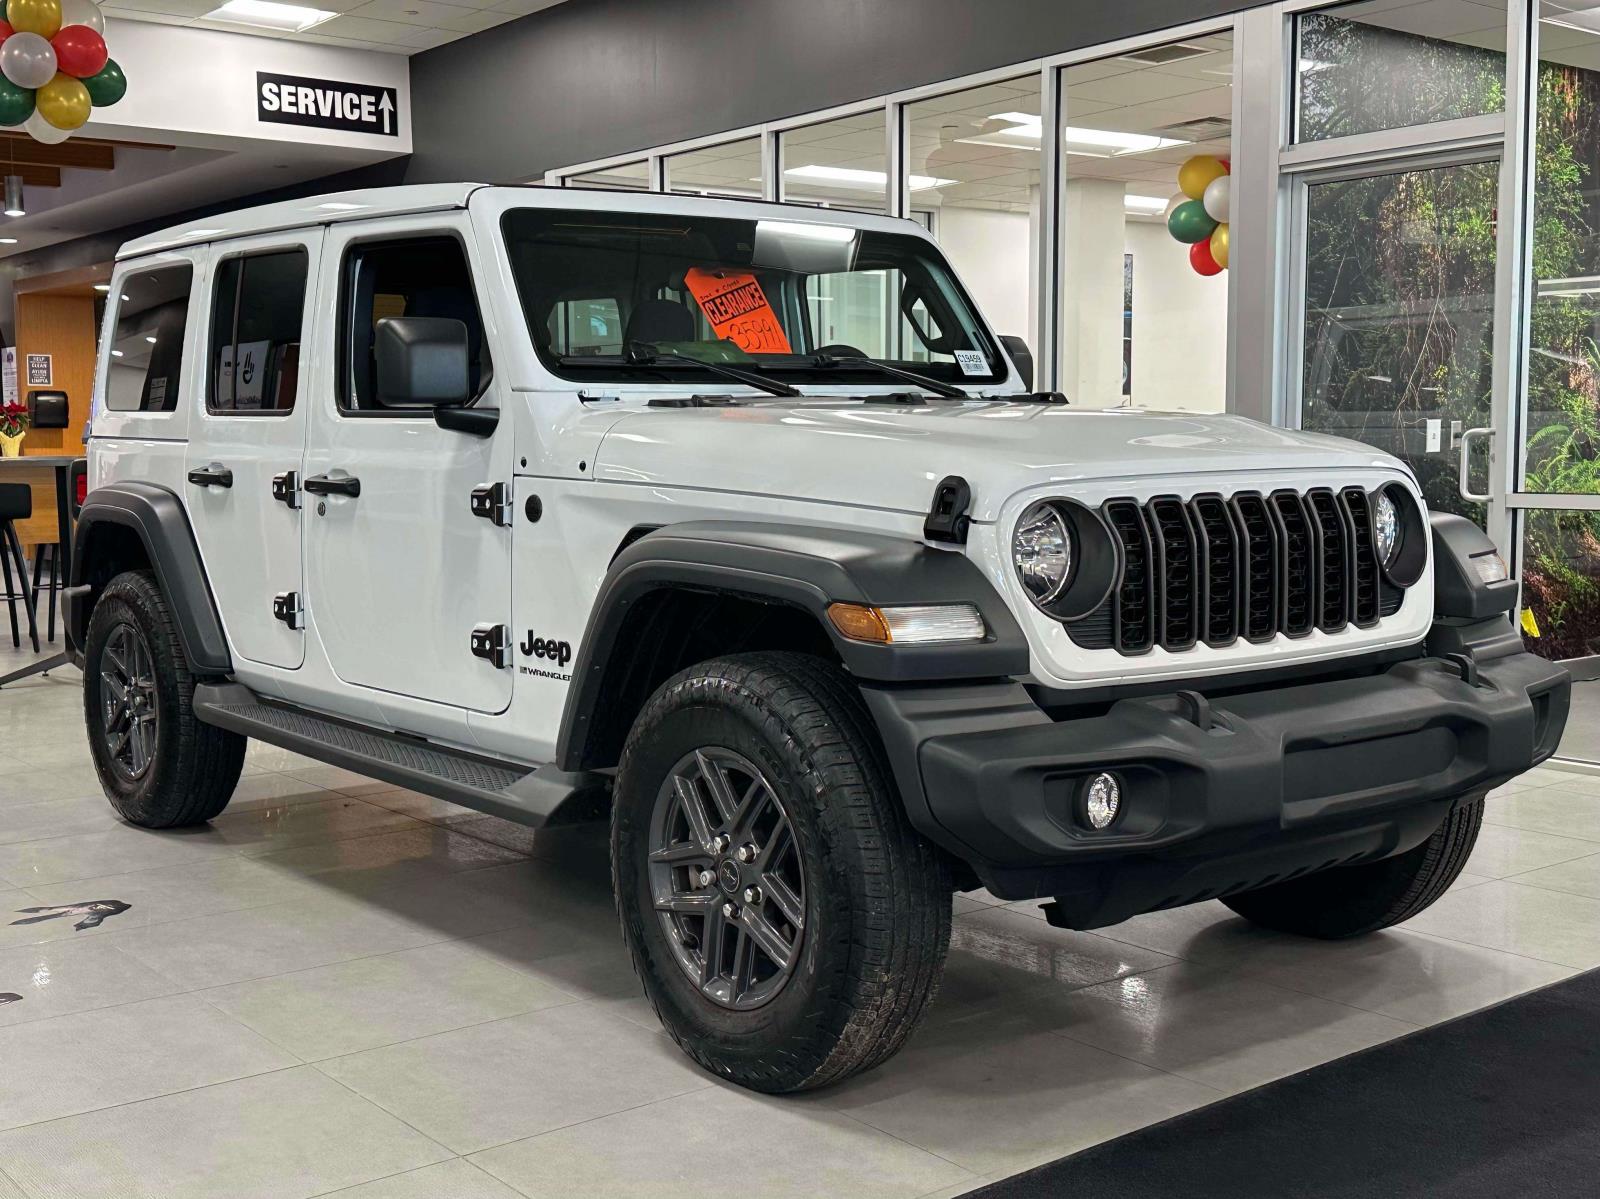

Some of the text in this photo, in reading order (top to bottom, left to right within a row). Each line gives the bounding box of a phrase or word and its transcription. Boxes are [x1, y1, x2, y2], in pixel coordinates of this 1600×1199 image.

[261, 82, 377, 122] SERVICE
[704, 285, 765, 324] CLEARANCE
[520, 629, 571, 667] Jeep
